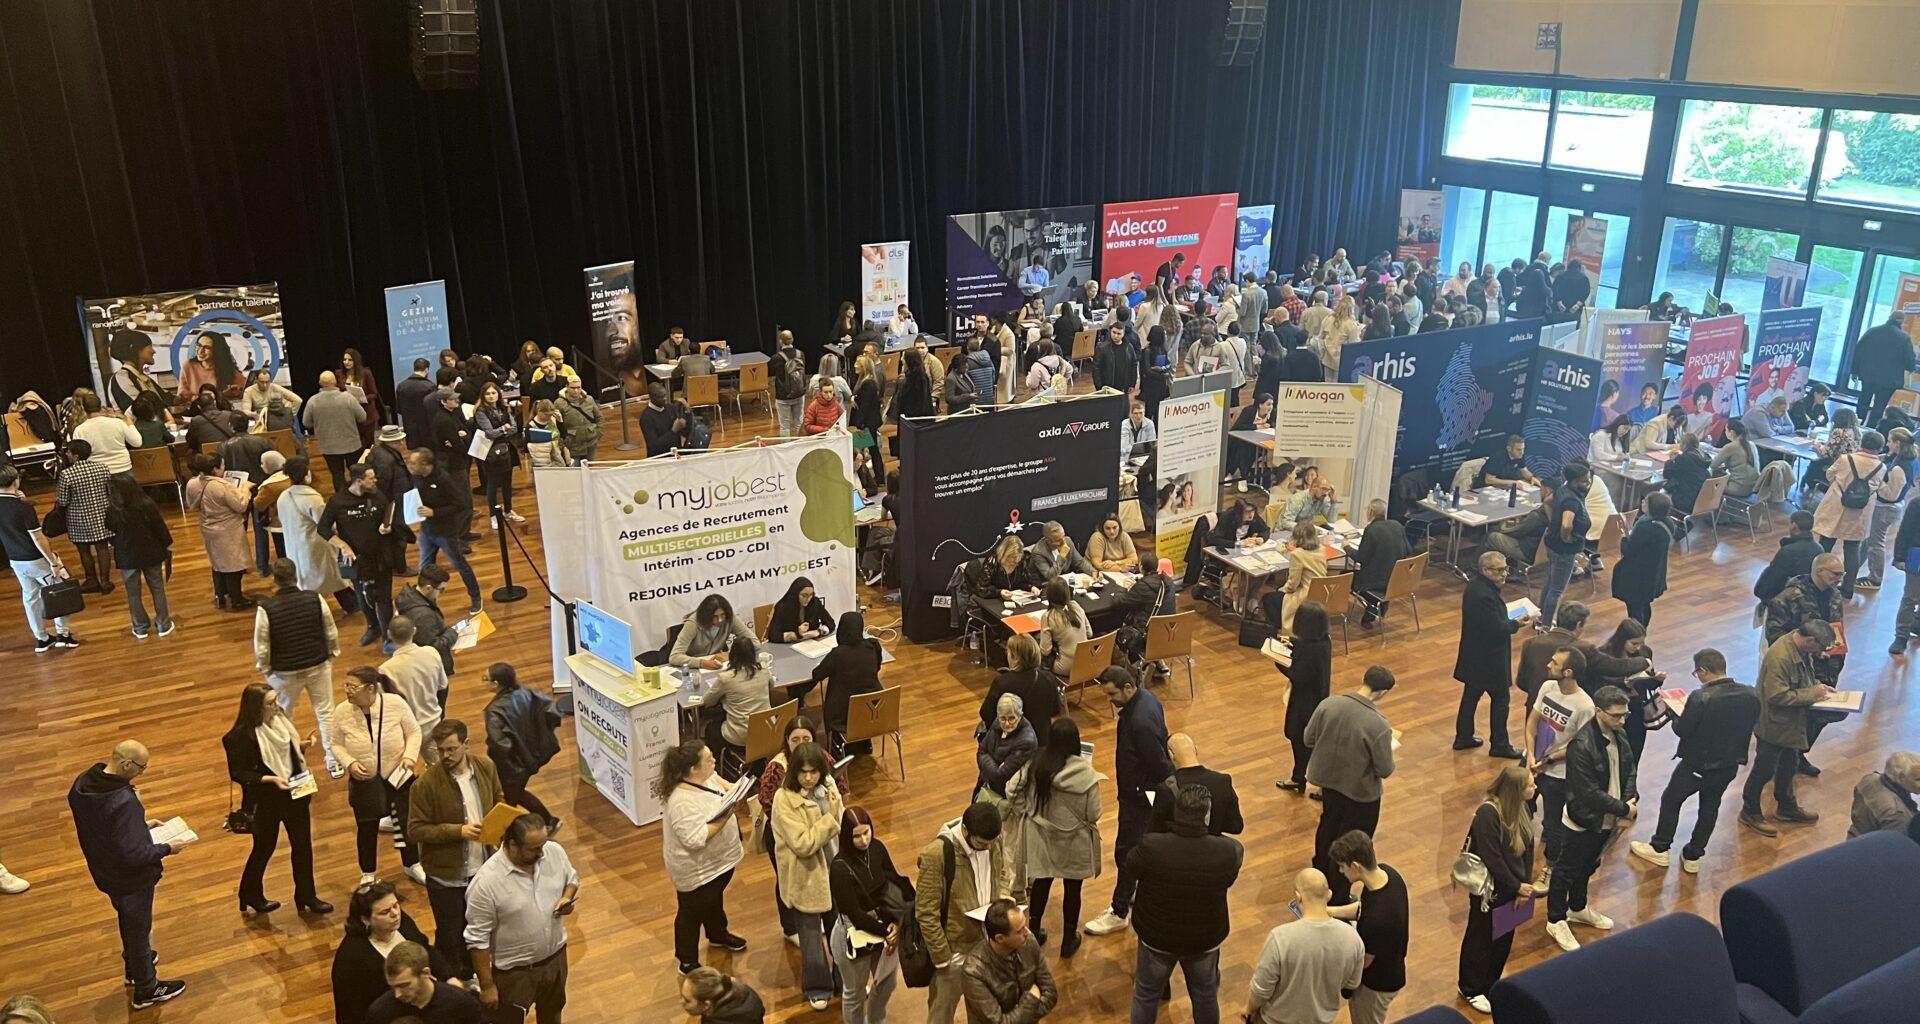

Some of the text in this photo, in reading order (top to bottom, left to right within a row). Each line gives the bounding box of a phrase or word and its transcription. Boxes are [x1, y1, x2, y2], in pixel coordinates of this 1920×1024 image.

[1054, 224, 1087, 235] Complete
[1106, 217, 1167, 237] Adecco
[1044, 234, 1067, 243] Talent
[1060, 240, 1088, 248] Solutions
[1106, 233, 1199, 249] WORKS FOR EVERYONE
[1051, 247, 1079, 255] Partner
[590, 285, 630, 300] J'ai trouvé
[198, 301, 230, 311] partner
[231, 297, 243, 307] for
[401, 305, 434, 317] GEZIM
[591, 302, 604, 310] ma
[1509, 332, 1533, 343] arhis.lu
[1759, 340, 1811, 356] PROCHAIN
[1688, 350, 1736, 367] PROCHAIN
[1769, 351, 1804, 369] JOB ?
[1351, 351, 1417, 383] arhis
[1542, 360, 1591, 388] arhis
[1697, 360, 1730, 380] JOB ?
[1295, 389, 1344, 403] Morgan
[1173, 402, 1210, 416] Morgan
[1038, 421, 1110, 438] axia GROUPE
[1024, 459, 1043, 468] groupe
[948, 477, 983, 488] accompagne
[1007, 467, 1035, 477] démarches
[1035, 465, 1049, 474] pour
[658, 472, 786, 511] myjobest
[934, 490, 955, 498] trouver
[1033, 497, 1057, 507] FRANCE
[1063, 490, 1106, 502] LUXEMBOURG
[618, 504, 789, 541] Agences de Recrutement
[627, 523, 784, 558] MULTISECTORIELLES en
[644, 556, 694, 572] Intérim
[706, 549, 736, 562] CDD
[747, 542, 770, 553] CDI
[629, 556, 831, 602] REJOINS LA TEAM MYJOBEST
[578, 700, 590, 718] ON
[590, 710, 629, 748] RECRUTE
[645, 738, 666, 748] France
